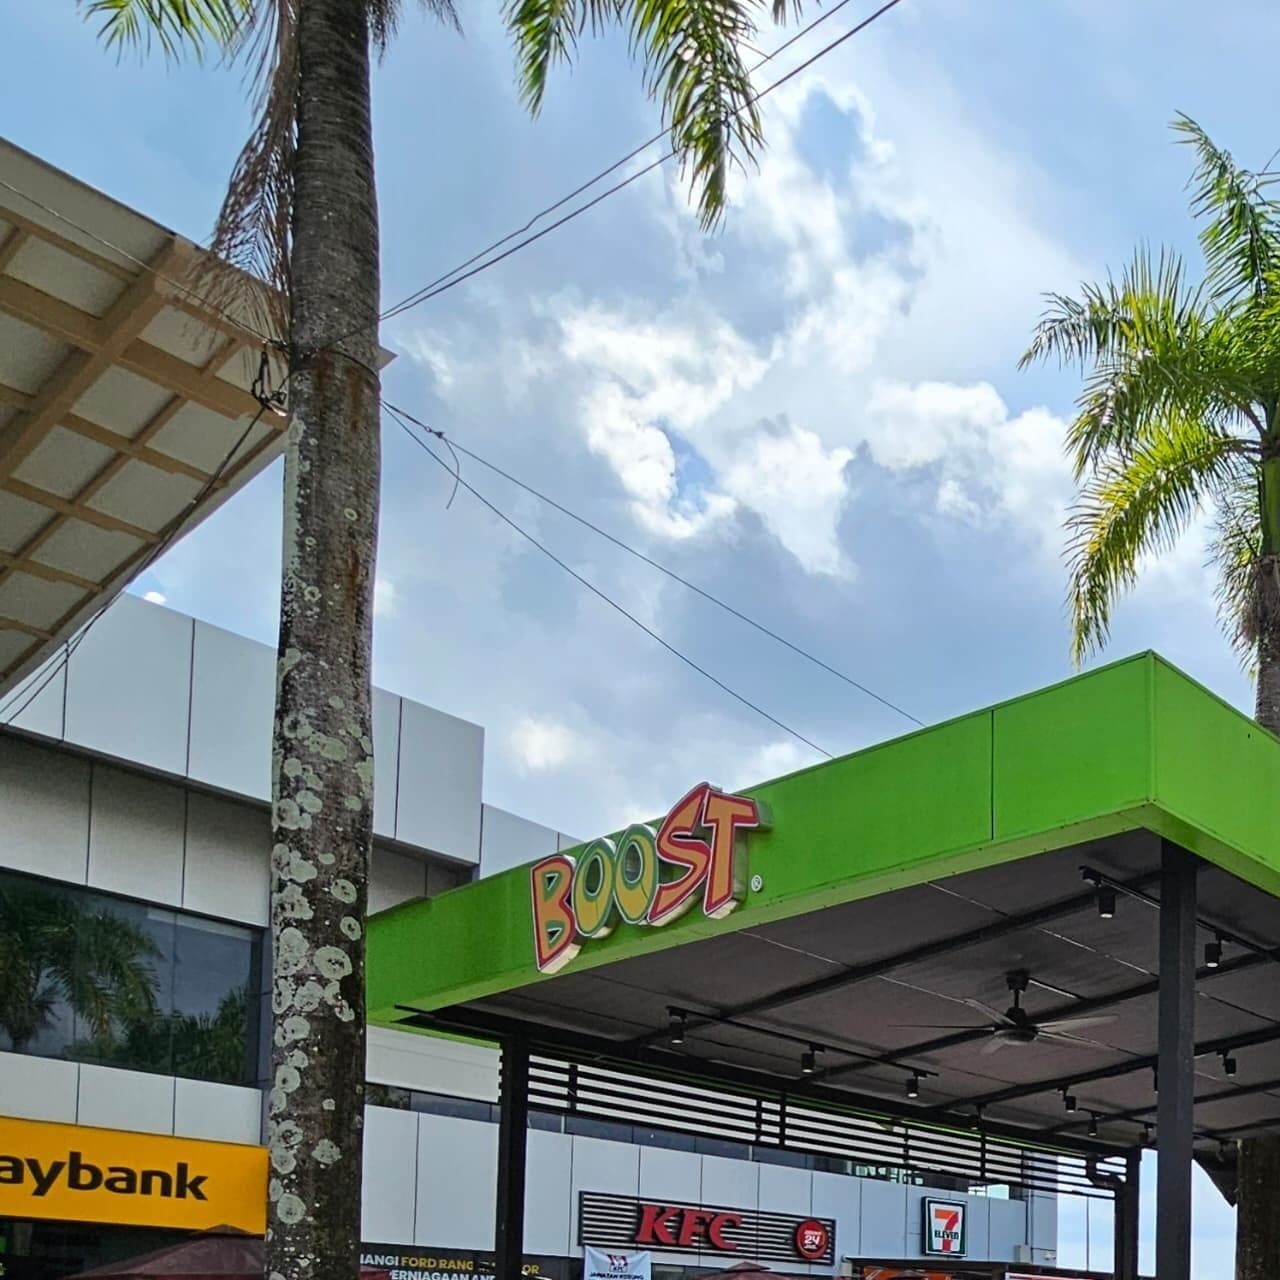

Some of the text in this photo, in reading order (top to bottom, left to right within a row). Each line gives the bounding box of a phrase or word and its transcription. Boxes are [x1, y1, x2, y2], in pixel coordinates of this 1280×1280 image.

[530, 781, 764, 971] BOOST
[0, 1151, 208, 1201] aybank
[634, 1204, 743, 1250] KFC
[804, 1234, 821, 1245] 24
[934, 1208, 959, 1252] 7
[360, 1253, 540, 1275] ANGI FORD RANG OR
